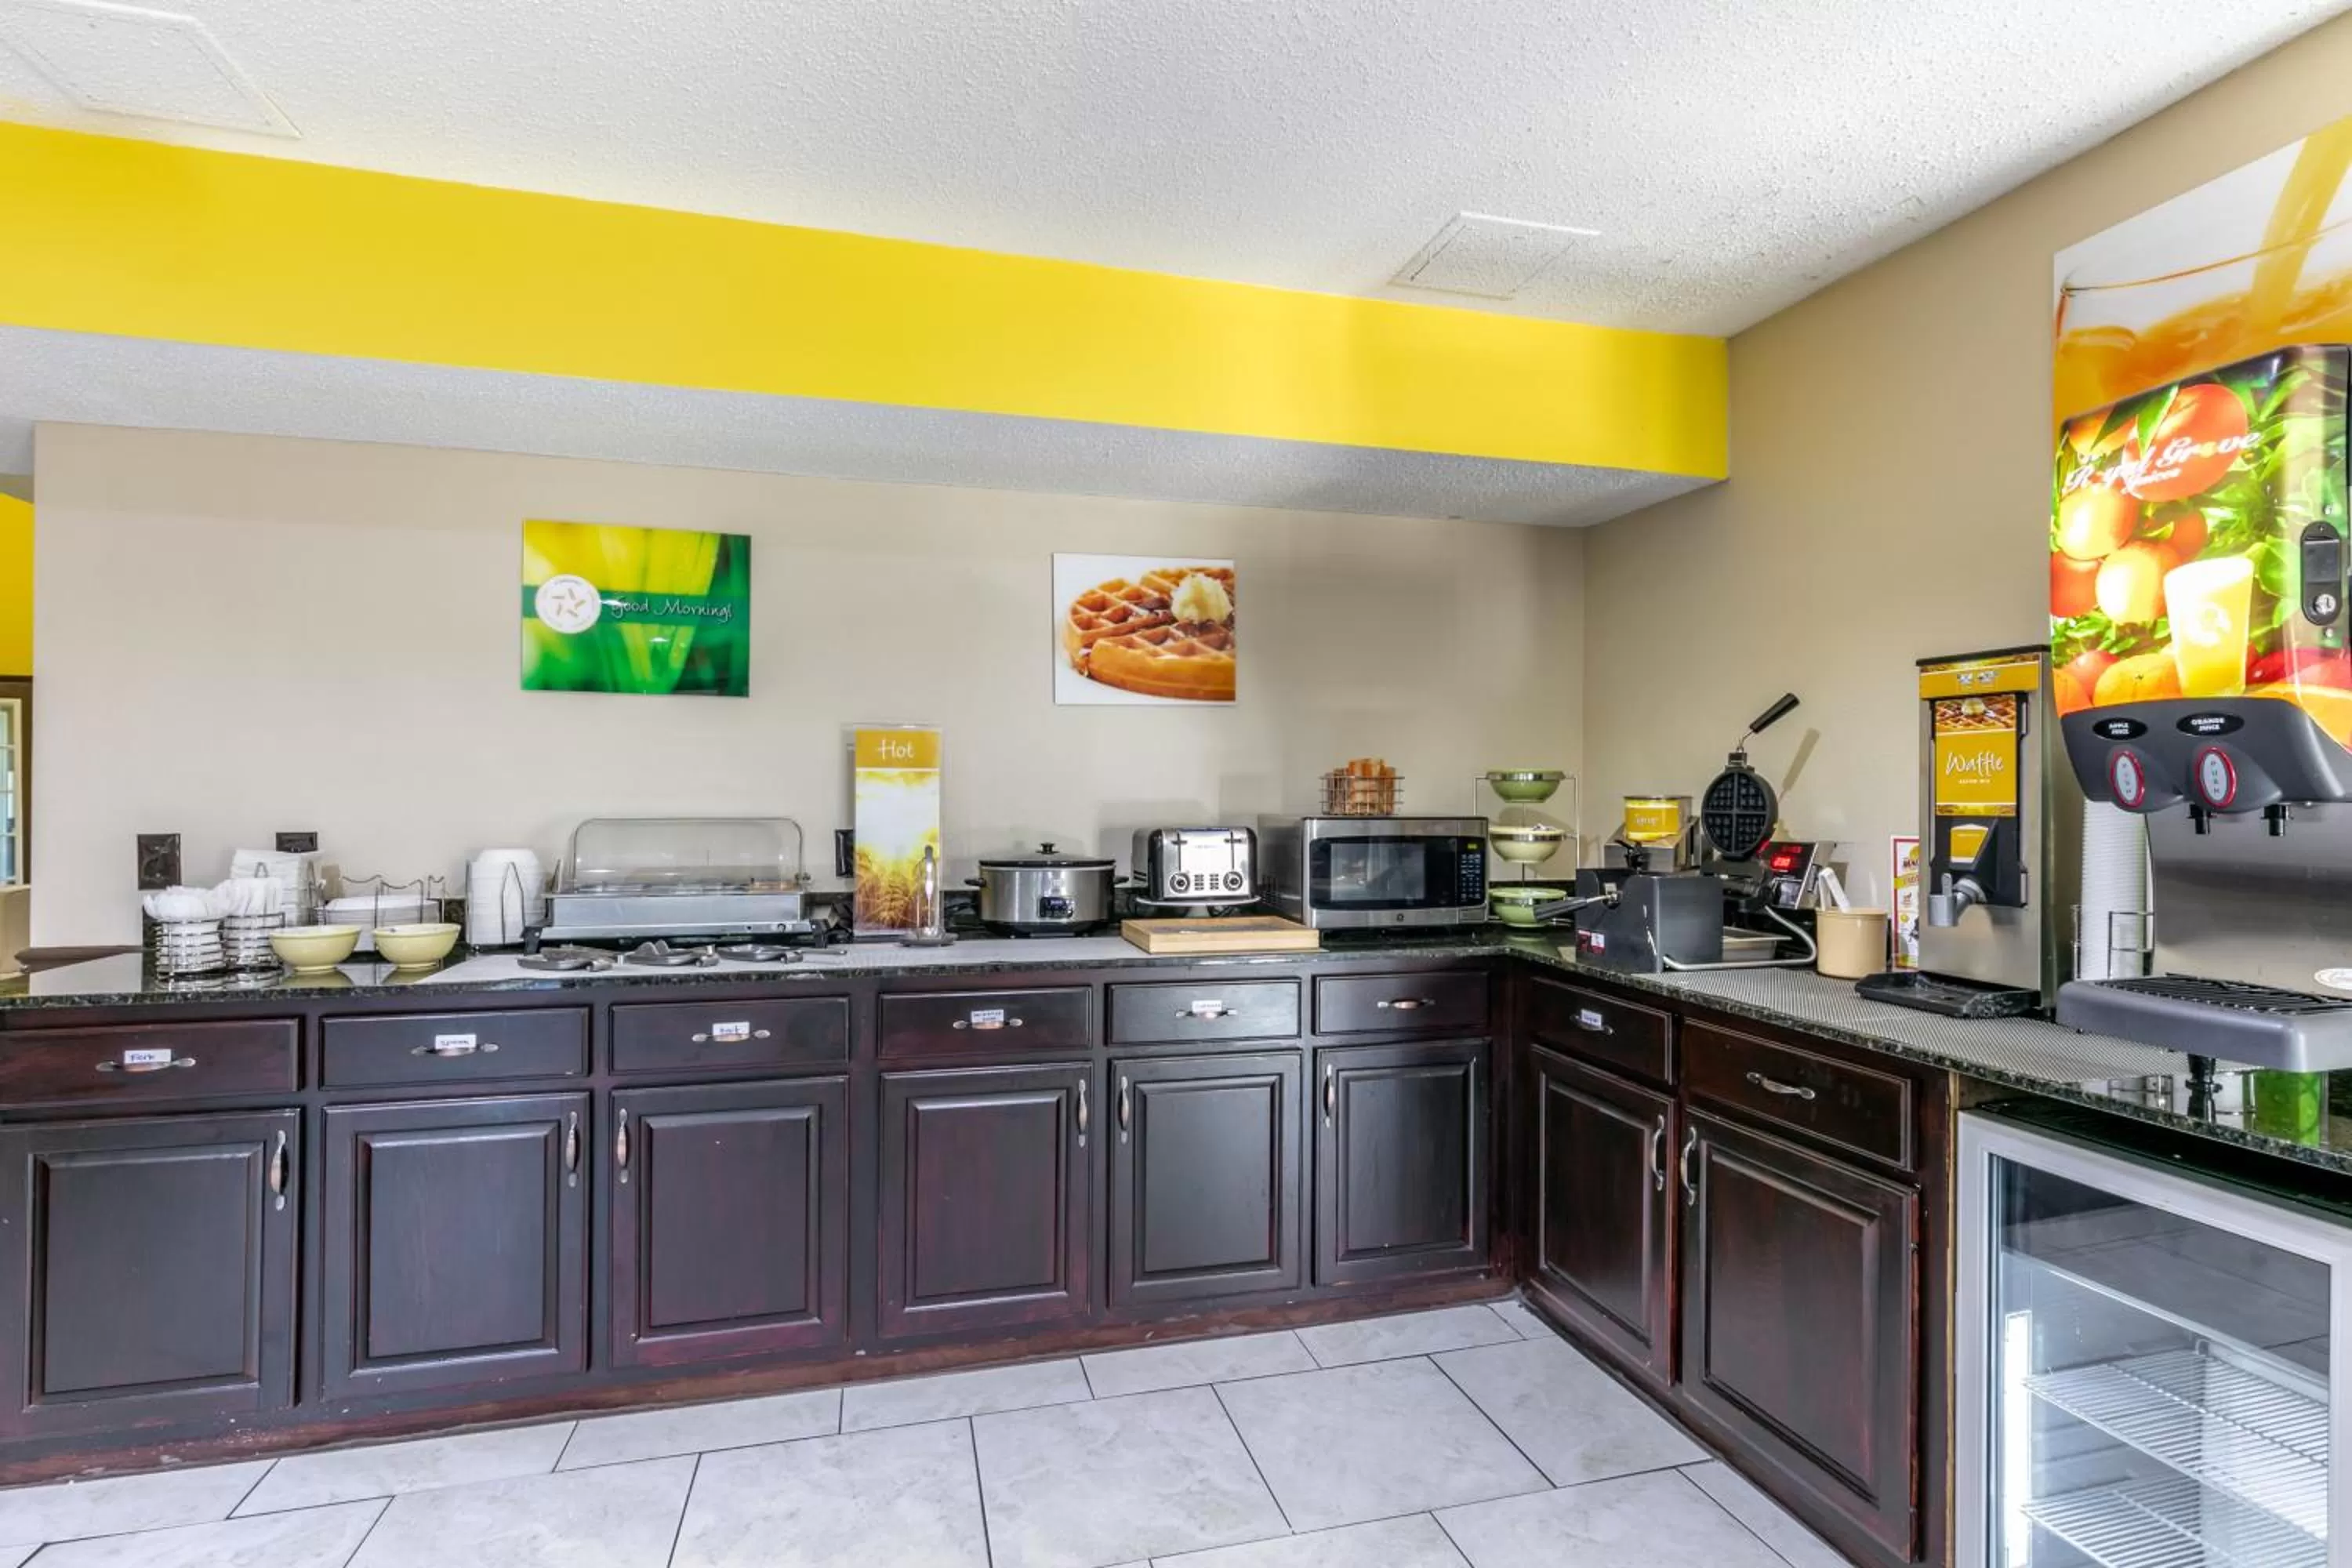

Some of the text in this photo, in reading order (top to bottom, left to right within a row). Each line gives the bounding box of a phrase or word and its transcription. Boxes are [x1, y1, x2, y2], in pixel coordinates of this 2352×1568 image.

[2155, 432, 2263, 469] Grove
[653, 598, 733, 625] Morning!
[2190, 717, 2225, 725] ORANGE
[874, 739, 916, 761] Hot
[1946, 751, 2004, 777] Waffle
